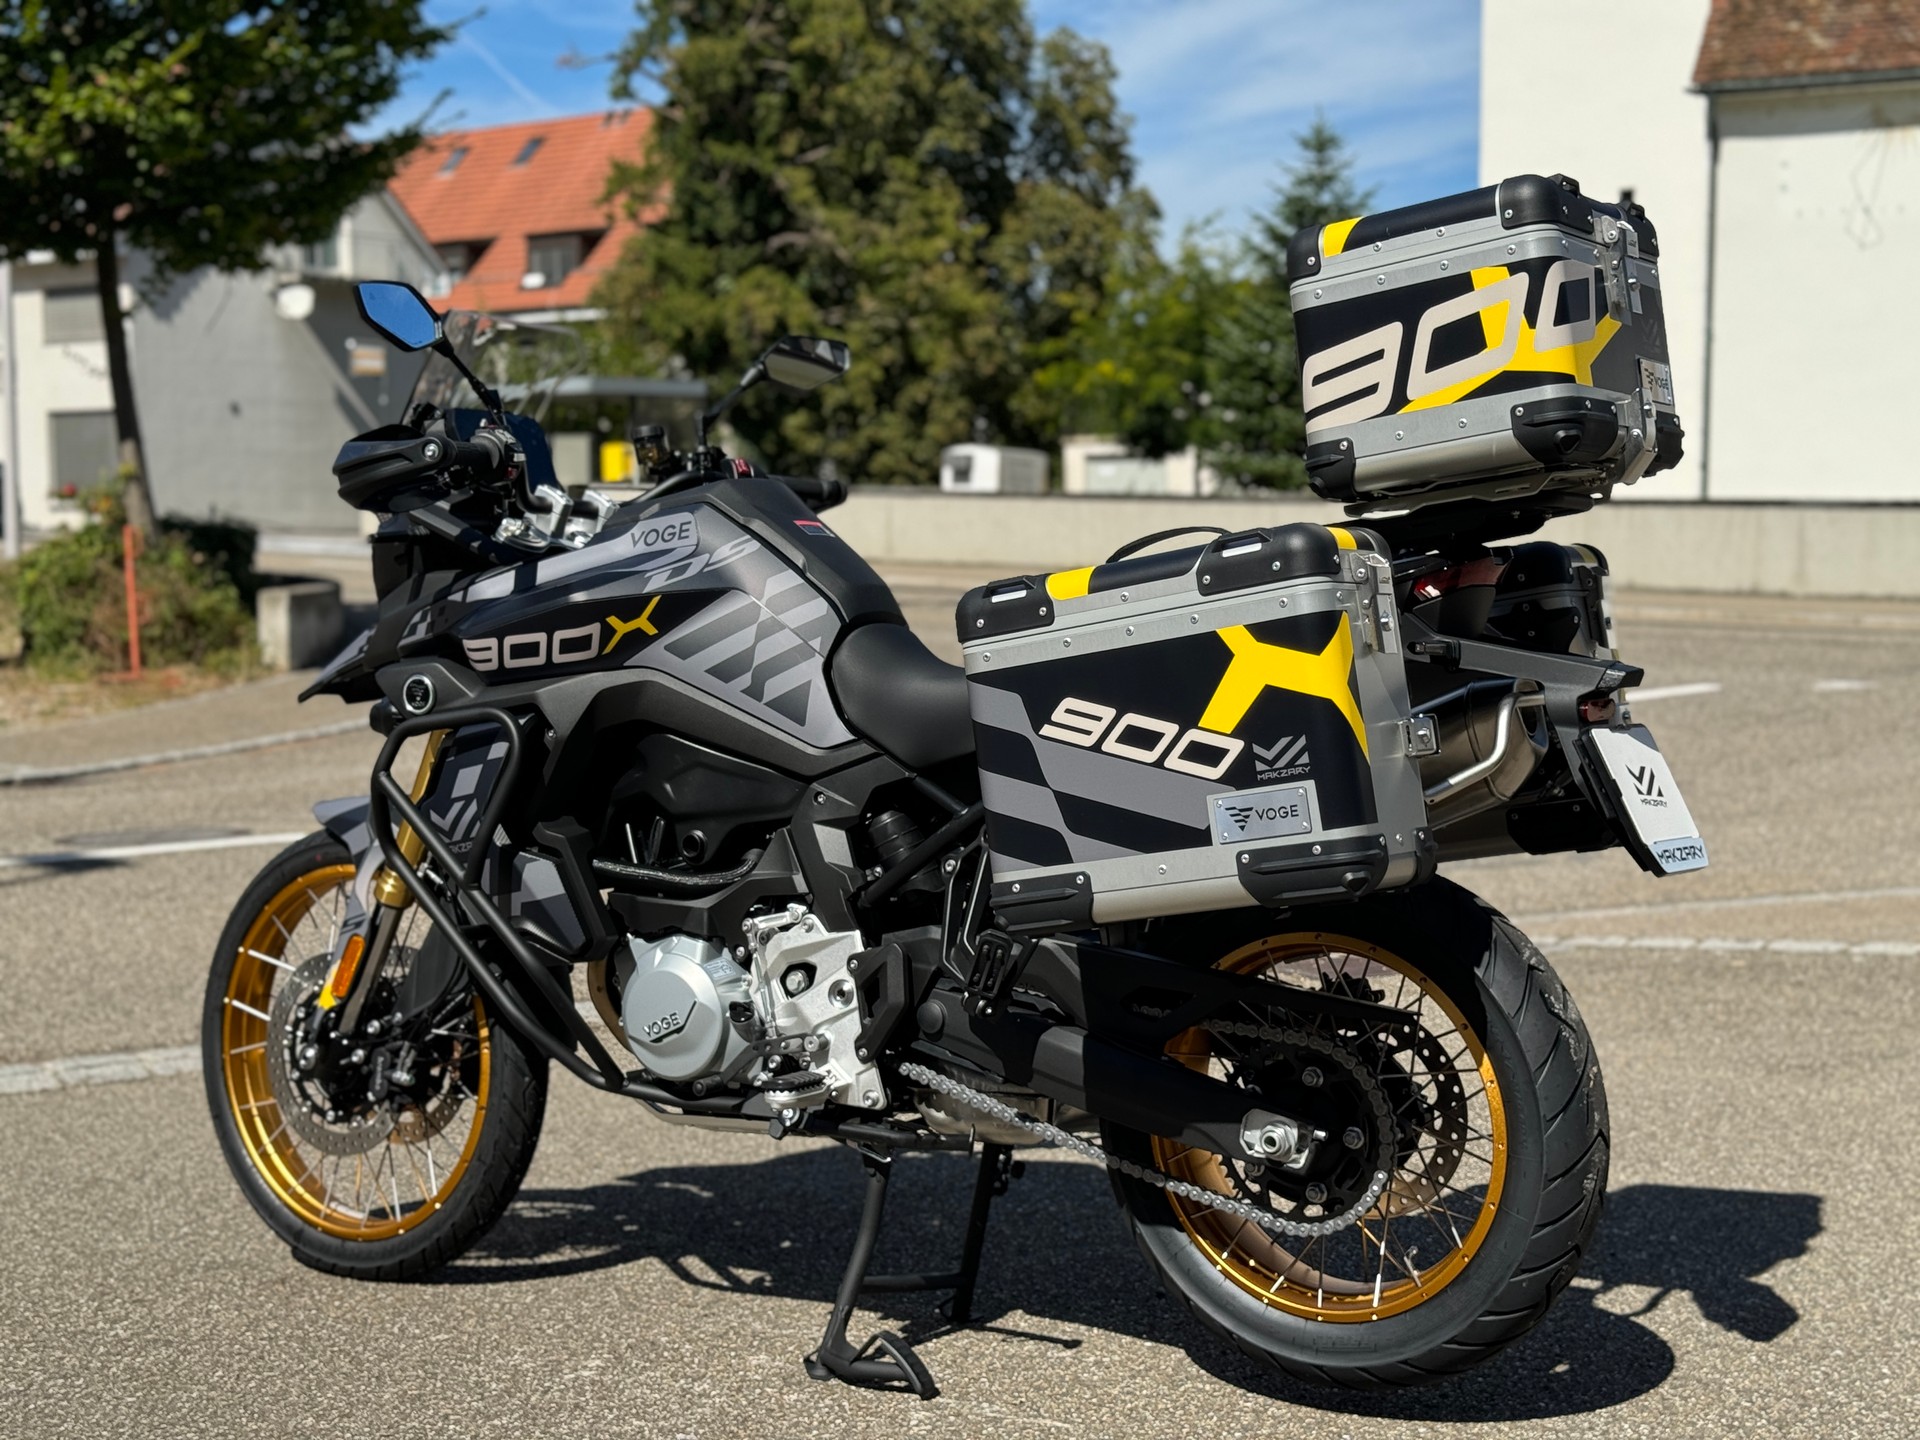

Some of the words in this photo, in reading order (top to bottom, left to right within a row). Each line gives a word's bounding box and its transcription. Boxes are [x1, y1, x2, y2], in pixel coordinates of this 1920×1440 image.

[630, 521, 692, 548] VOGE
[642, 534, 761, 594] DS
[1038, 697, 1245, 780] 900
[1256, 765, 1311, 781] MAKZARY
[1255, 804, 1299, 820] VOGE
[1655, 844, 1705, 865] MAKZARY
[643, 1012, 681, 1037] VOGE
